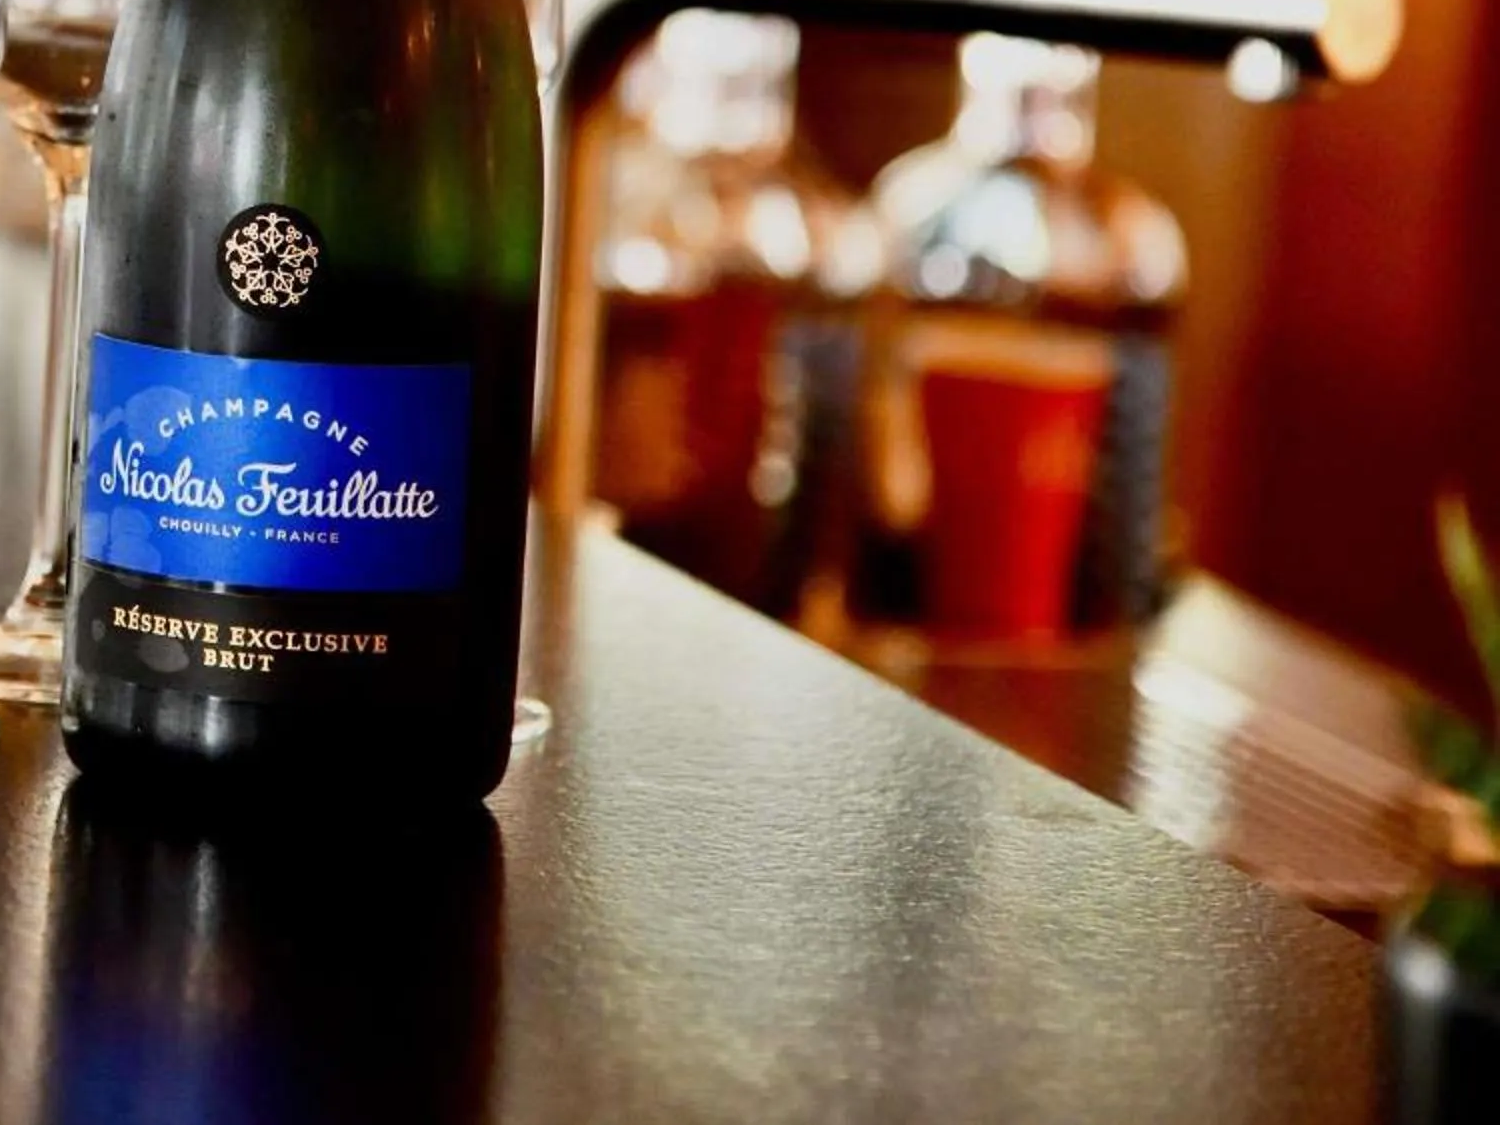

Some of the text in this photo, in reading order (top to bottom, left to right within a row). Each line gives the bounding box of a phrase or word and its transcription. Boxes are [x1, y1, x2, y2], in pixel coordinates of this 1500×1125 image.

[158, 397, 369, 457] CHAMPAGNE
[100, 437, 440, 520] Nicolas Feuillatte
[159, 515, 242, 539] CHOUILLY
[265, 527, 340, 544] FRANCE
[112, 604, 388, 654] RÉSERVE EXCLUSIVE
[203, 648, 274, 673] BRUT
